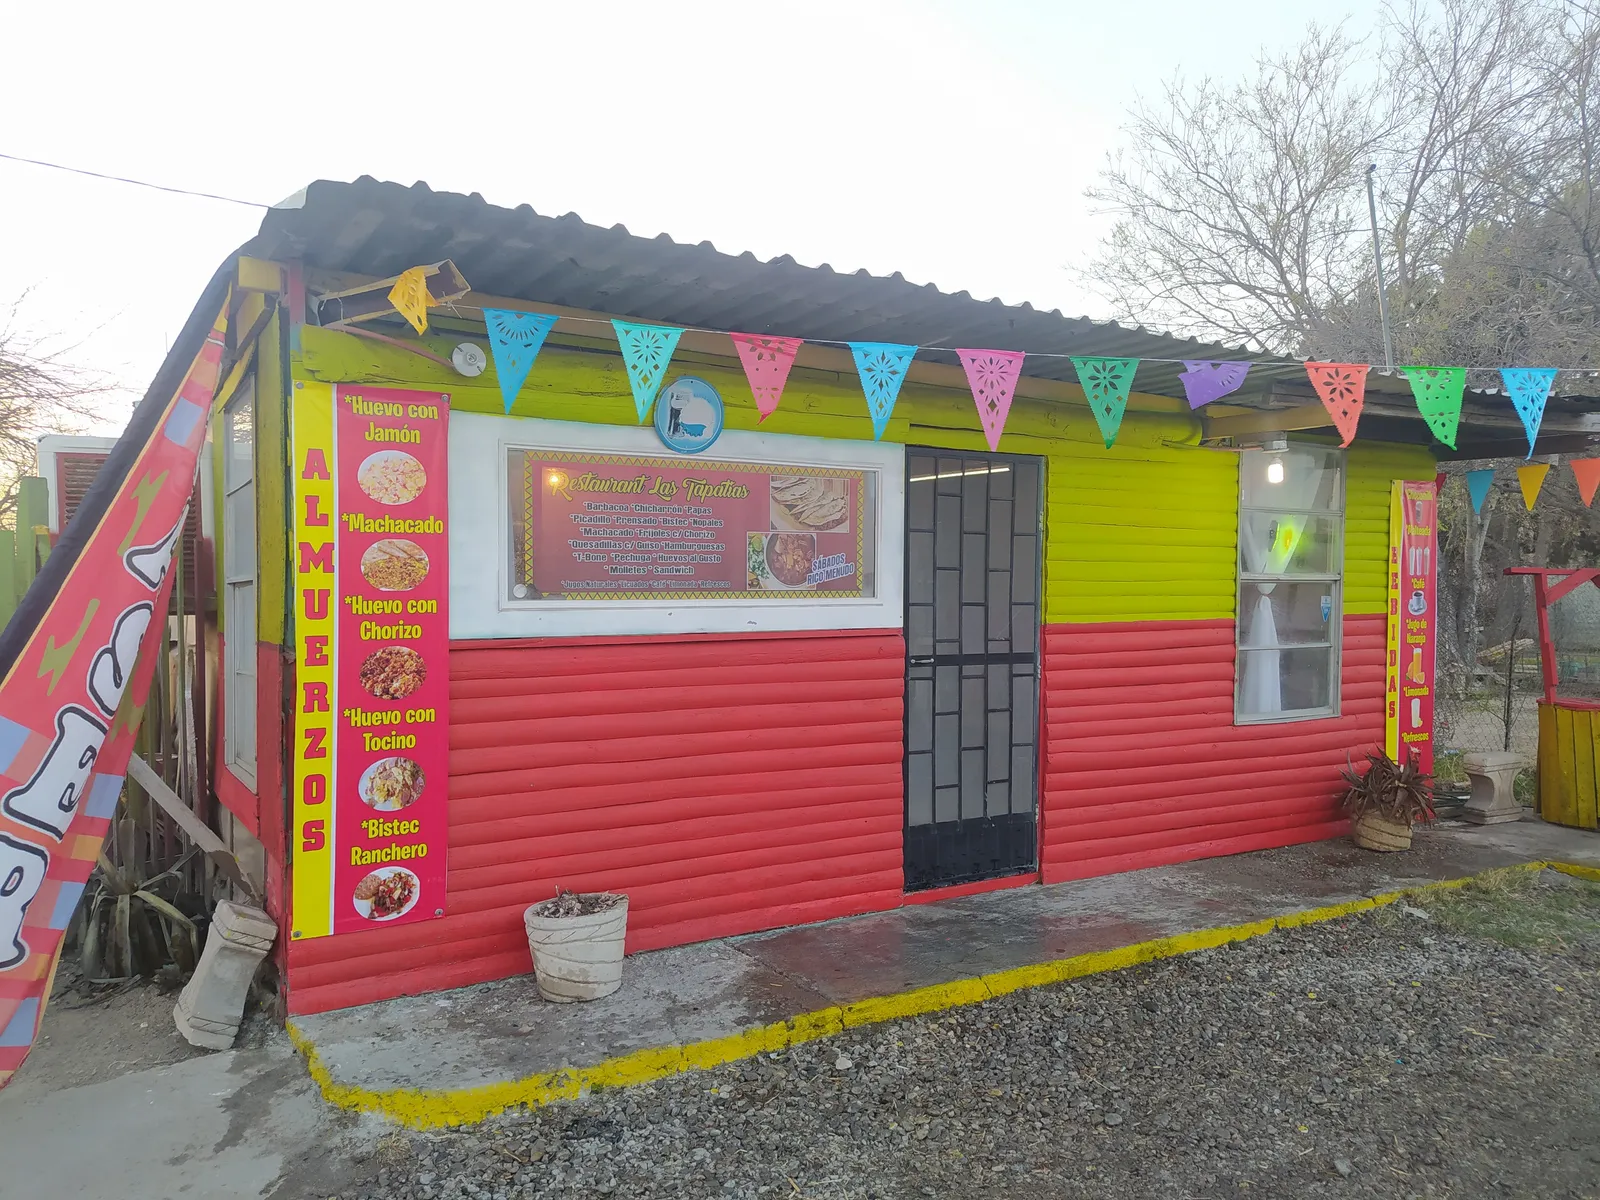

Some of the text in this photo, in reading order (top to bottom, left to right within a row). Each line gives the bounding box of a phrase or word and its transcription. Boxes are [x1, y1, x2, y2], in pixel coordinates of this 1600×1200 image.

[407, 403, 438, 420] con
[364, 422, 421, 444] Jamón
[552, 470, 650, 502] Restaurant
[648, 475, 678, 502] Las
[684, 529, 715, 539] Chorizo
[636, 540, 660, 550] Guiso
[658, 554, 688, 563] Huevos
[689, 554, 697, 562] al
[698, 554, 722, 563] Gusto
[609, 565, 694, 575] Molletes Sandwich
[806, 562, 856, 586] RICO MENUDO
[407, 598, 438, 615] con
[360, 619, 422, 641] Chorizo
[299, 448, 335, 852] ALMUERZOS
[405, 706, 436, 723] con
[363, 731, 416, 752] Tocino
[351, 842, 428, 866] Ranchero
